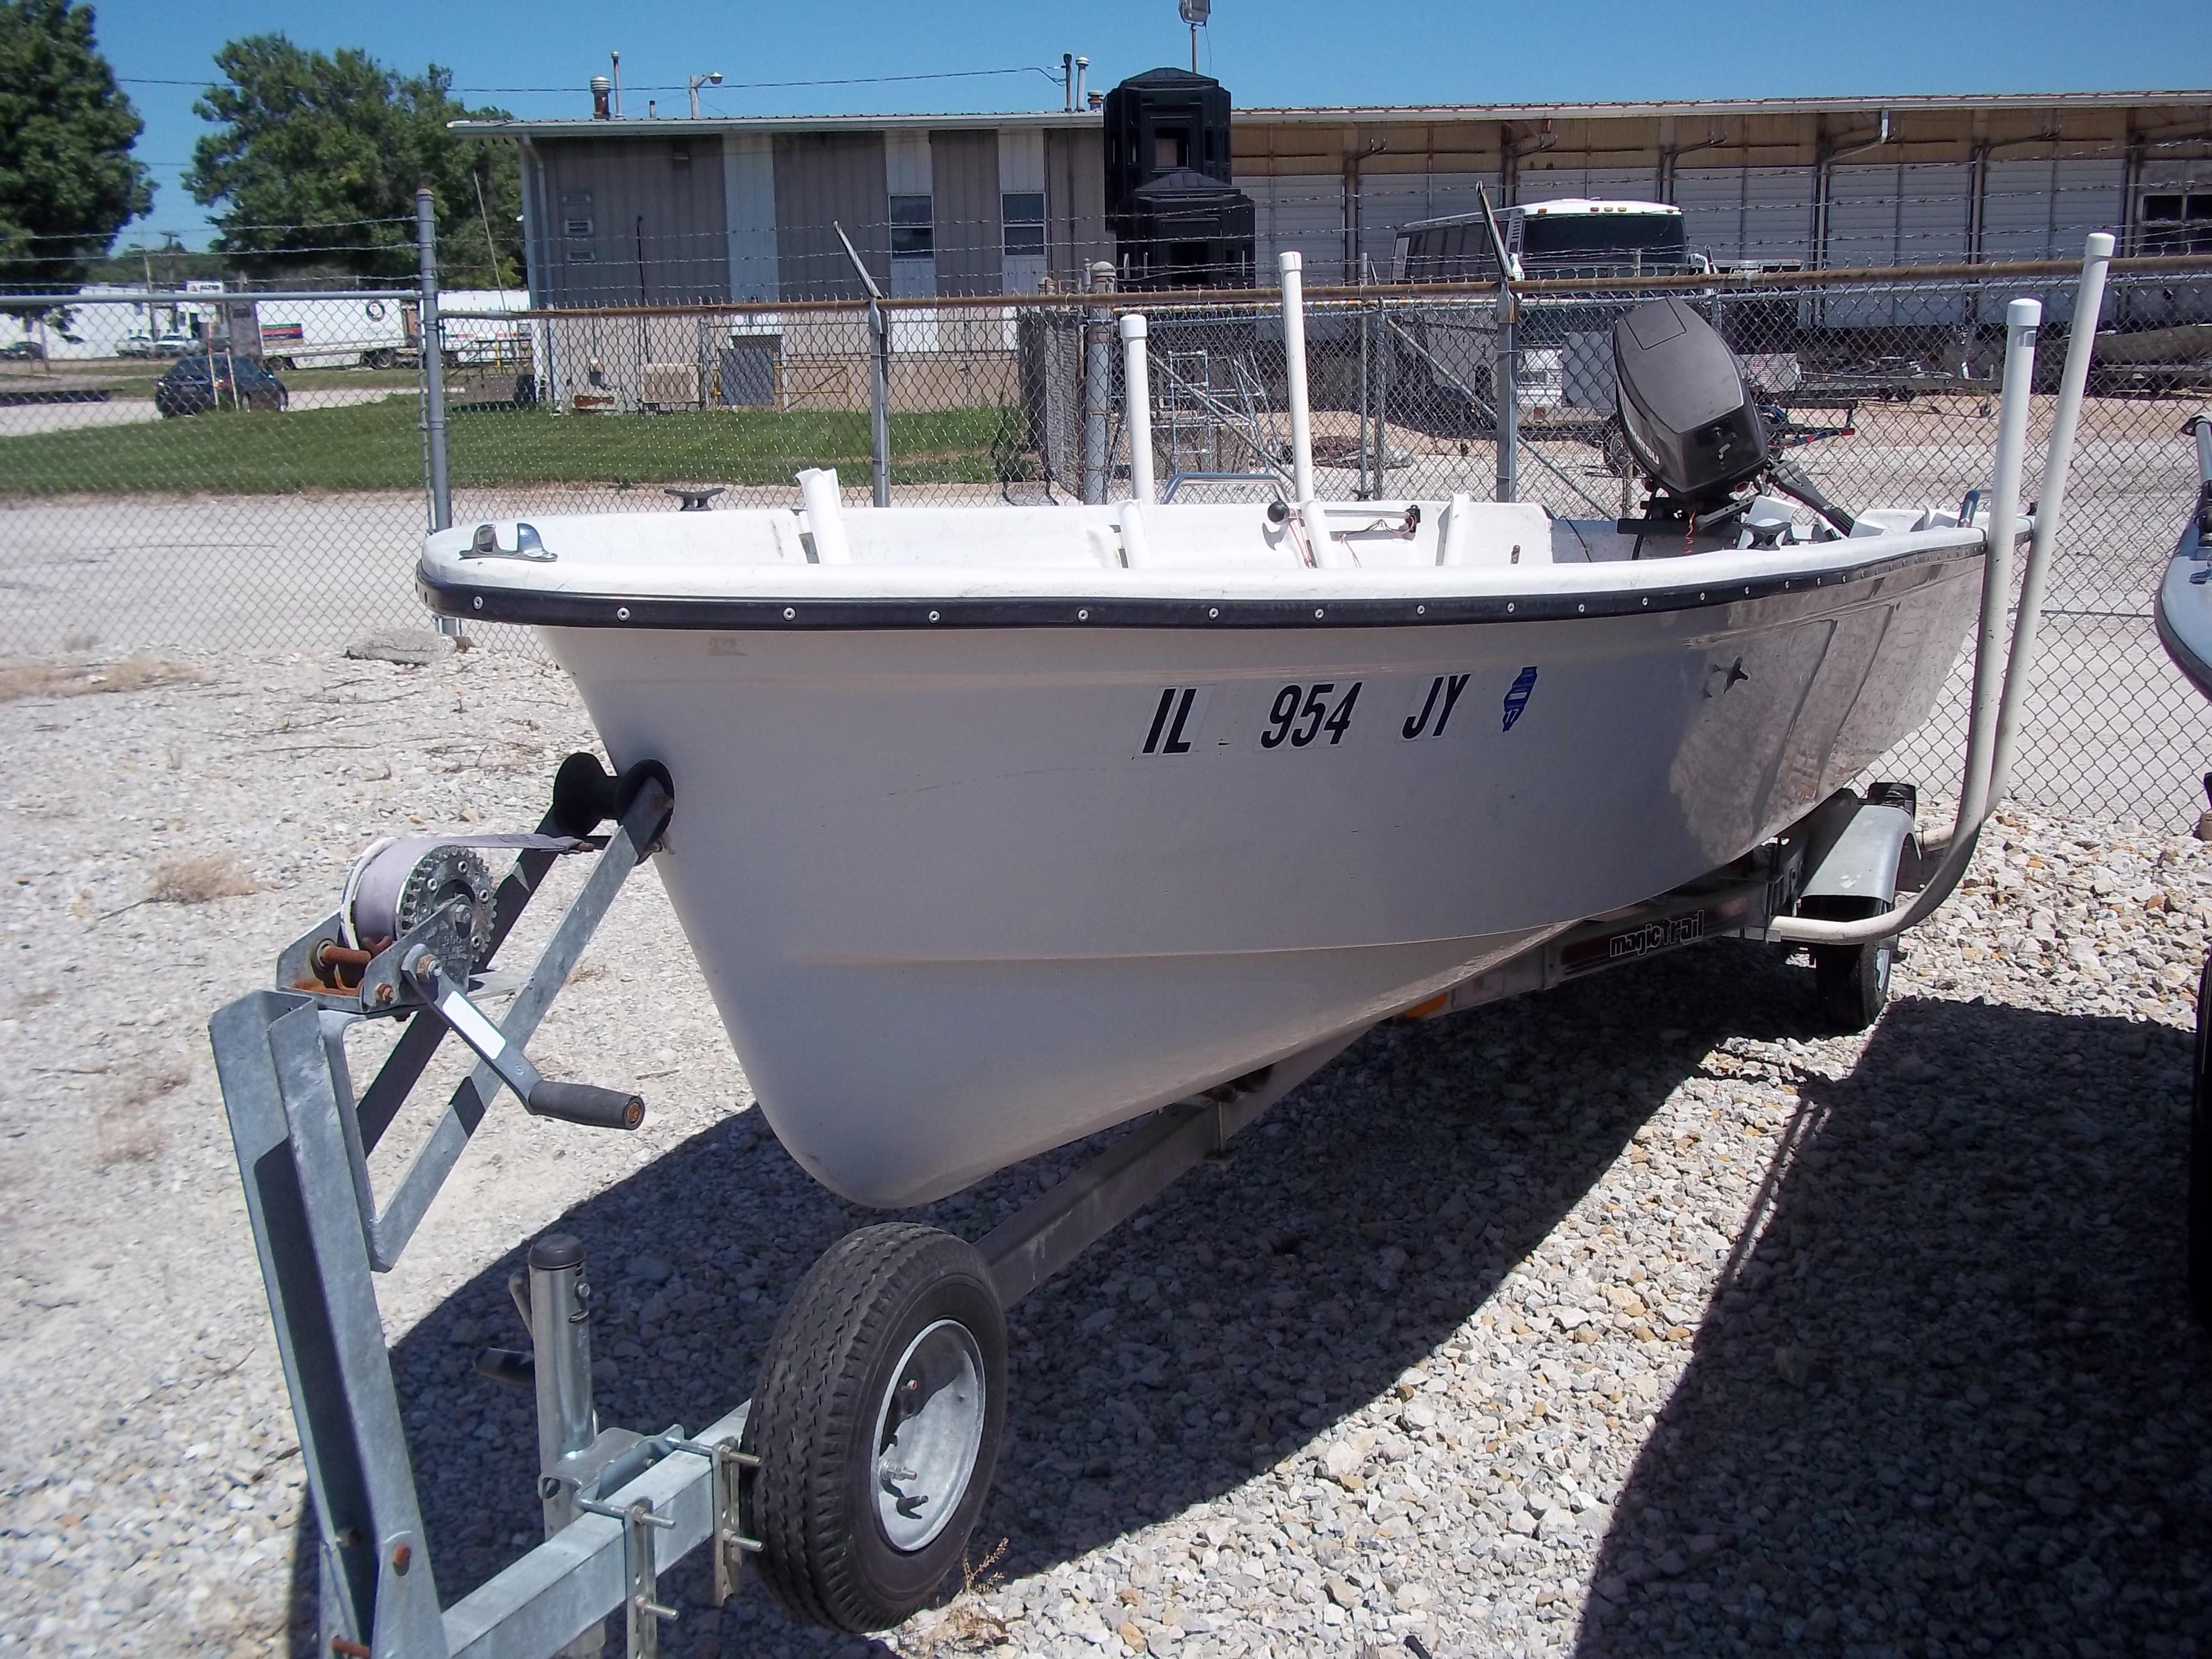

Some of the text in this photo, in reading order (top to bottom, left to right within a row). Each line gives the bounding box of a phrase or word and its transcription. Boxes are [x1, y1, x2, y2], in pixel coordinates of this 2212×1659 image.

[1141, 673, 1472, 754] IL 954 JY
[1505, 708, 1520, 723] 17
